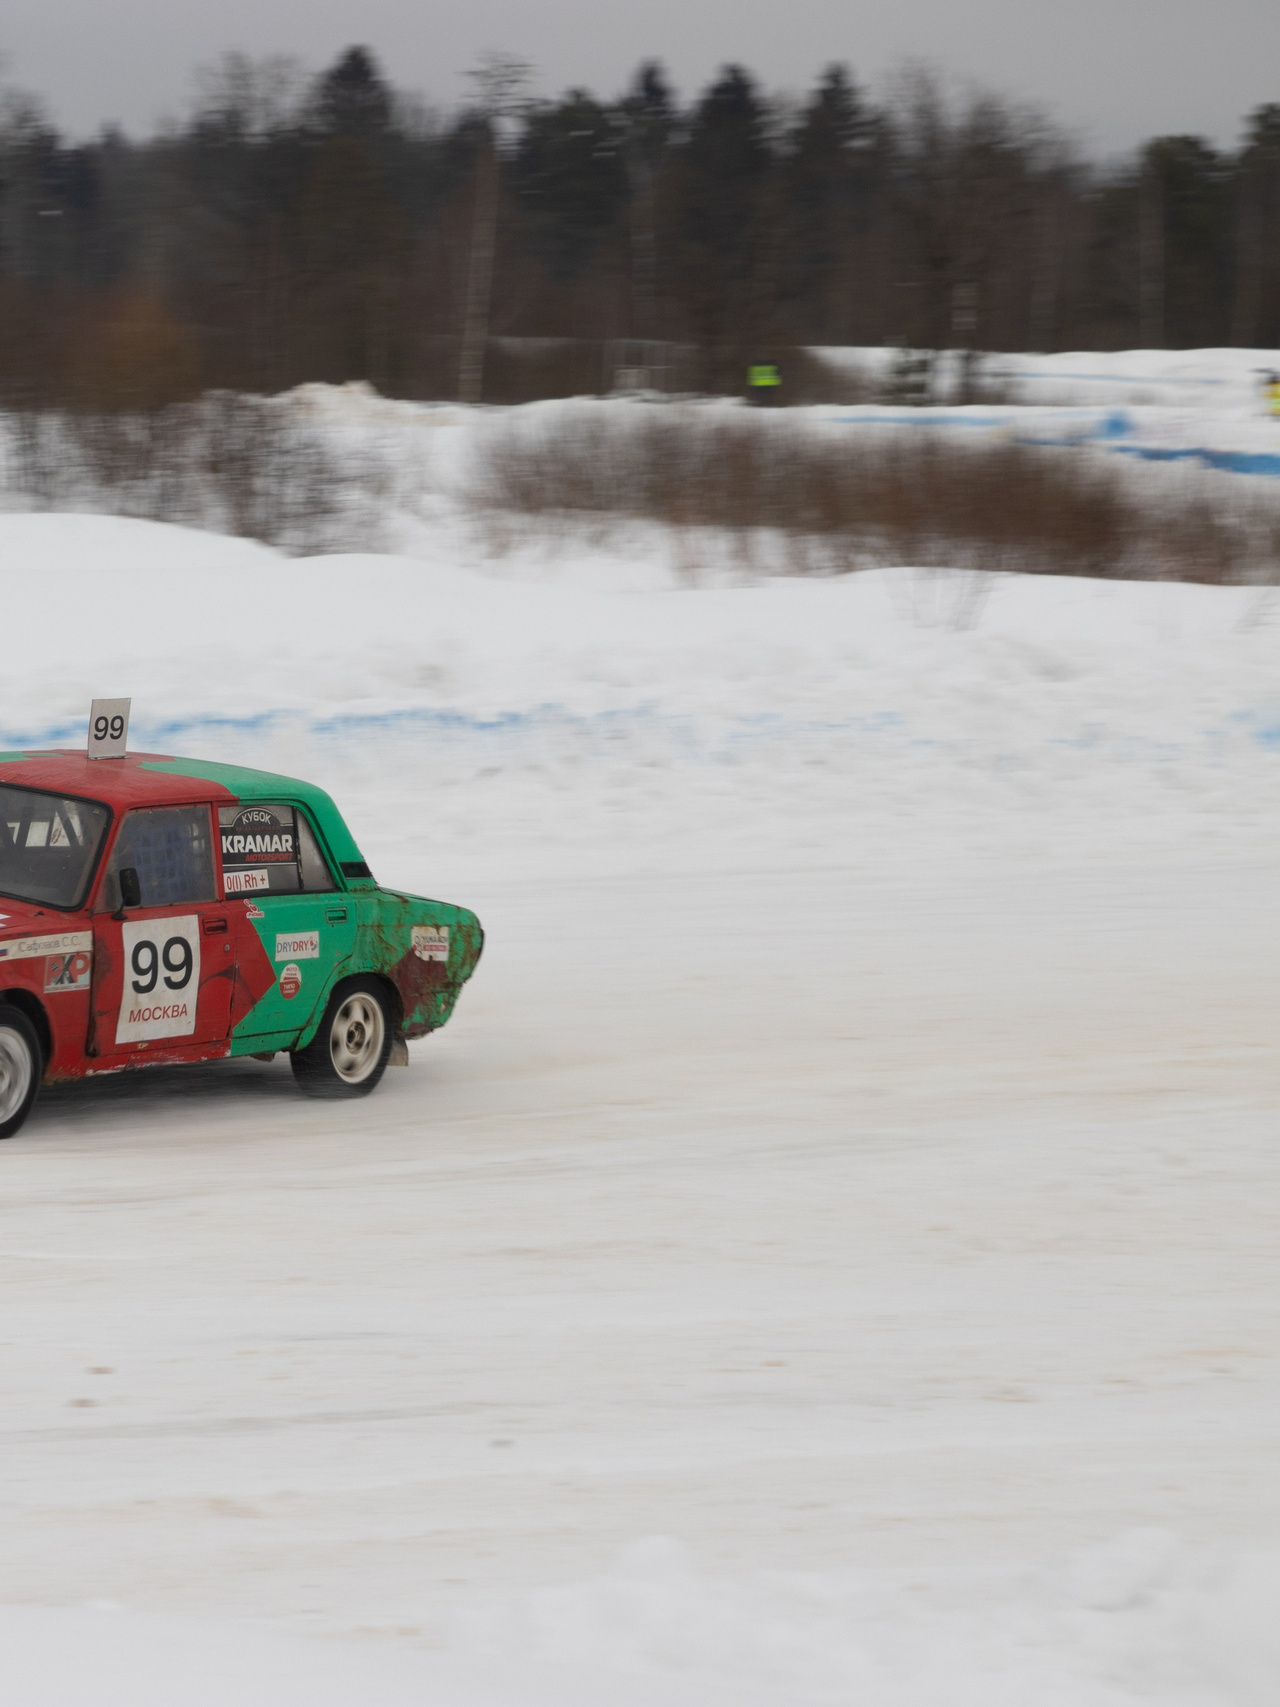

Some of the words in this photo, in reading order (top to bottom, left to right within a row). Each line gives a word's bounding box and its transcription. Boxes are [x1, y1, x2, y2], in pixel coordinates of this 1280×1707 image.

[94, 715, 124, 740] 99
[241, 811, 271, 825] КУБОК
[222, 834, 293, 853] KRAMAR
[245, 853, 293, 862] MOTORSPORT
[244, 873, 258, 889] Rh
[131, 936, 193, 994] 99
[128, 1003, 188, 1023] МОСКВА
